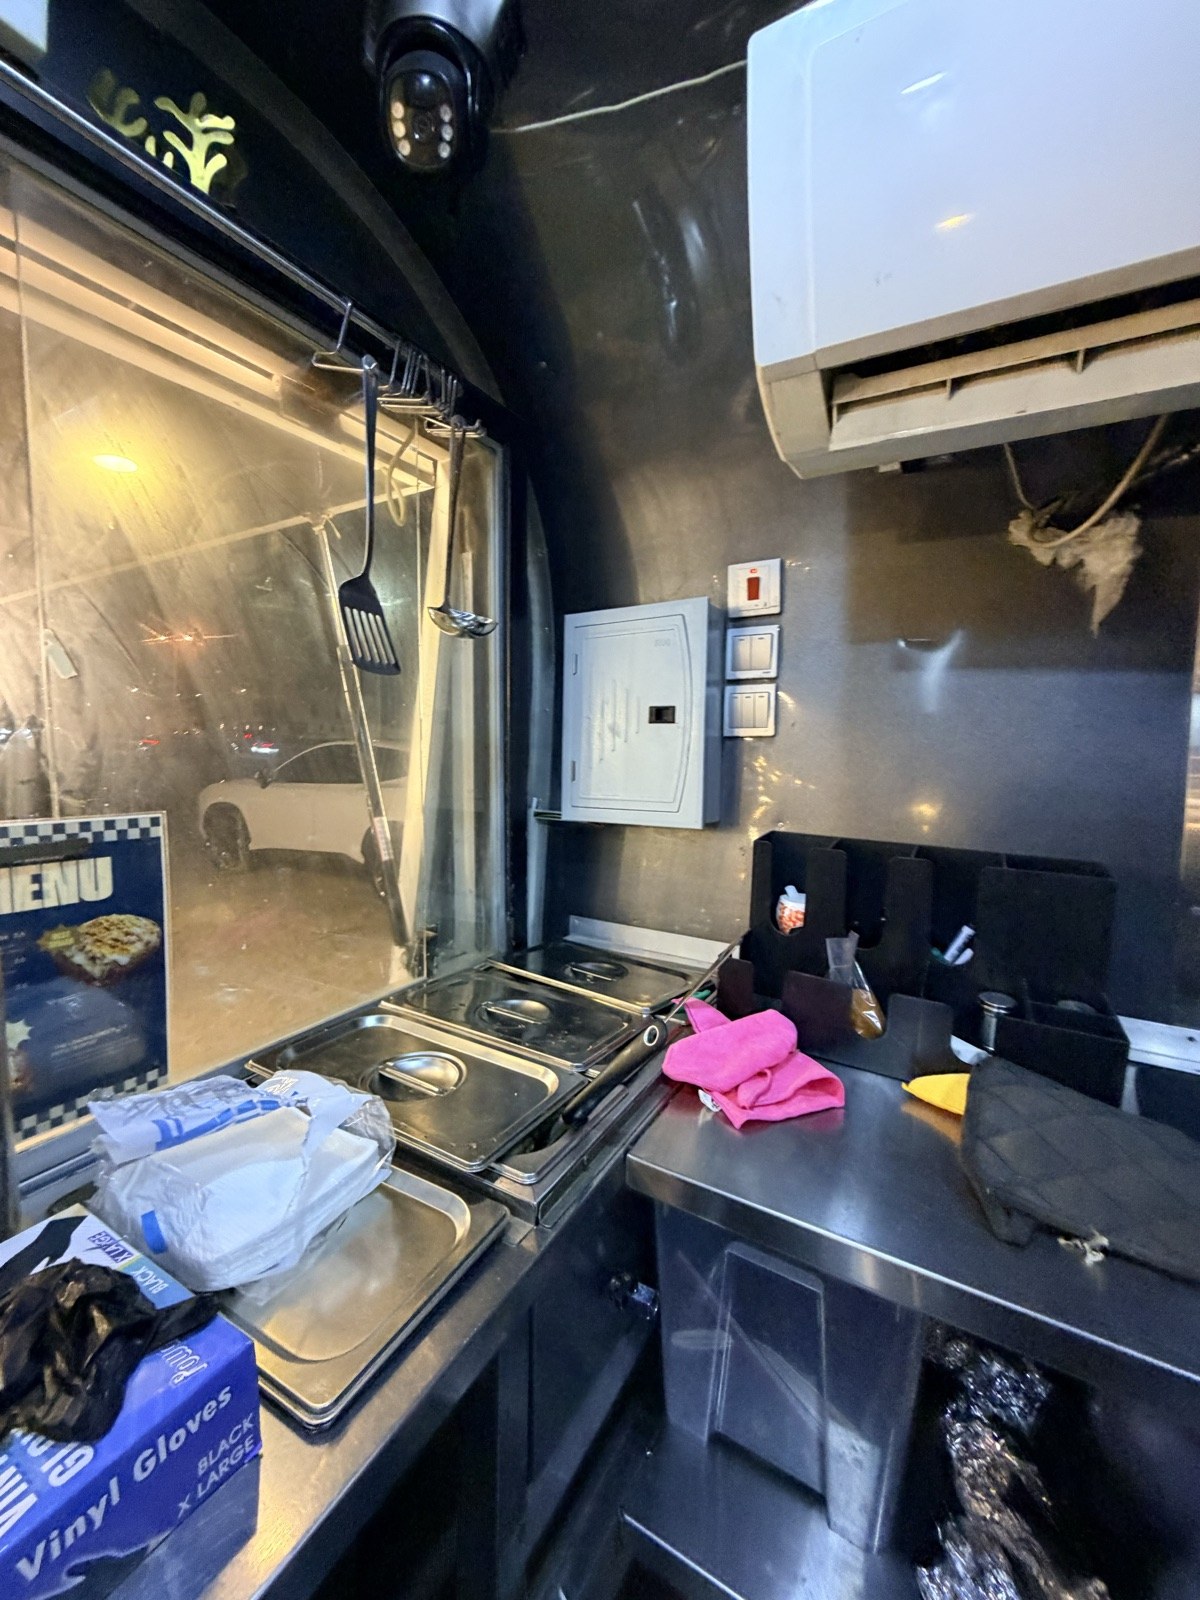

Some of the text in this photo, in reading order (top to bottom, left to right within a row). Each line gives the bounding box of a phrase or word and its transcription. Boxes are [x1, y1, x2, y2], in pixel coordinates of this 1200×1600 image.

[0, 857, 113, 914] ENU
[131, 1266, 169, 1294] BLACK
[160, 1344, 208, 1386] Pow
[197, 1412, 254, 1476] BLACK
[15, 1386, 232, 1582] Vinyl Gloves
[178, 1434, 255, 1519] X LARGE
